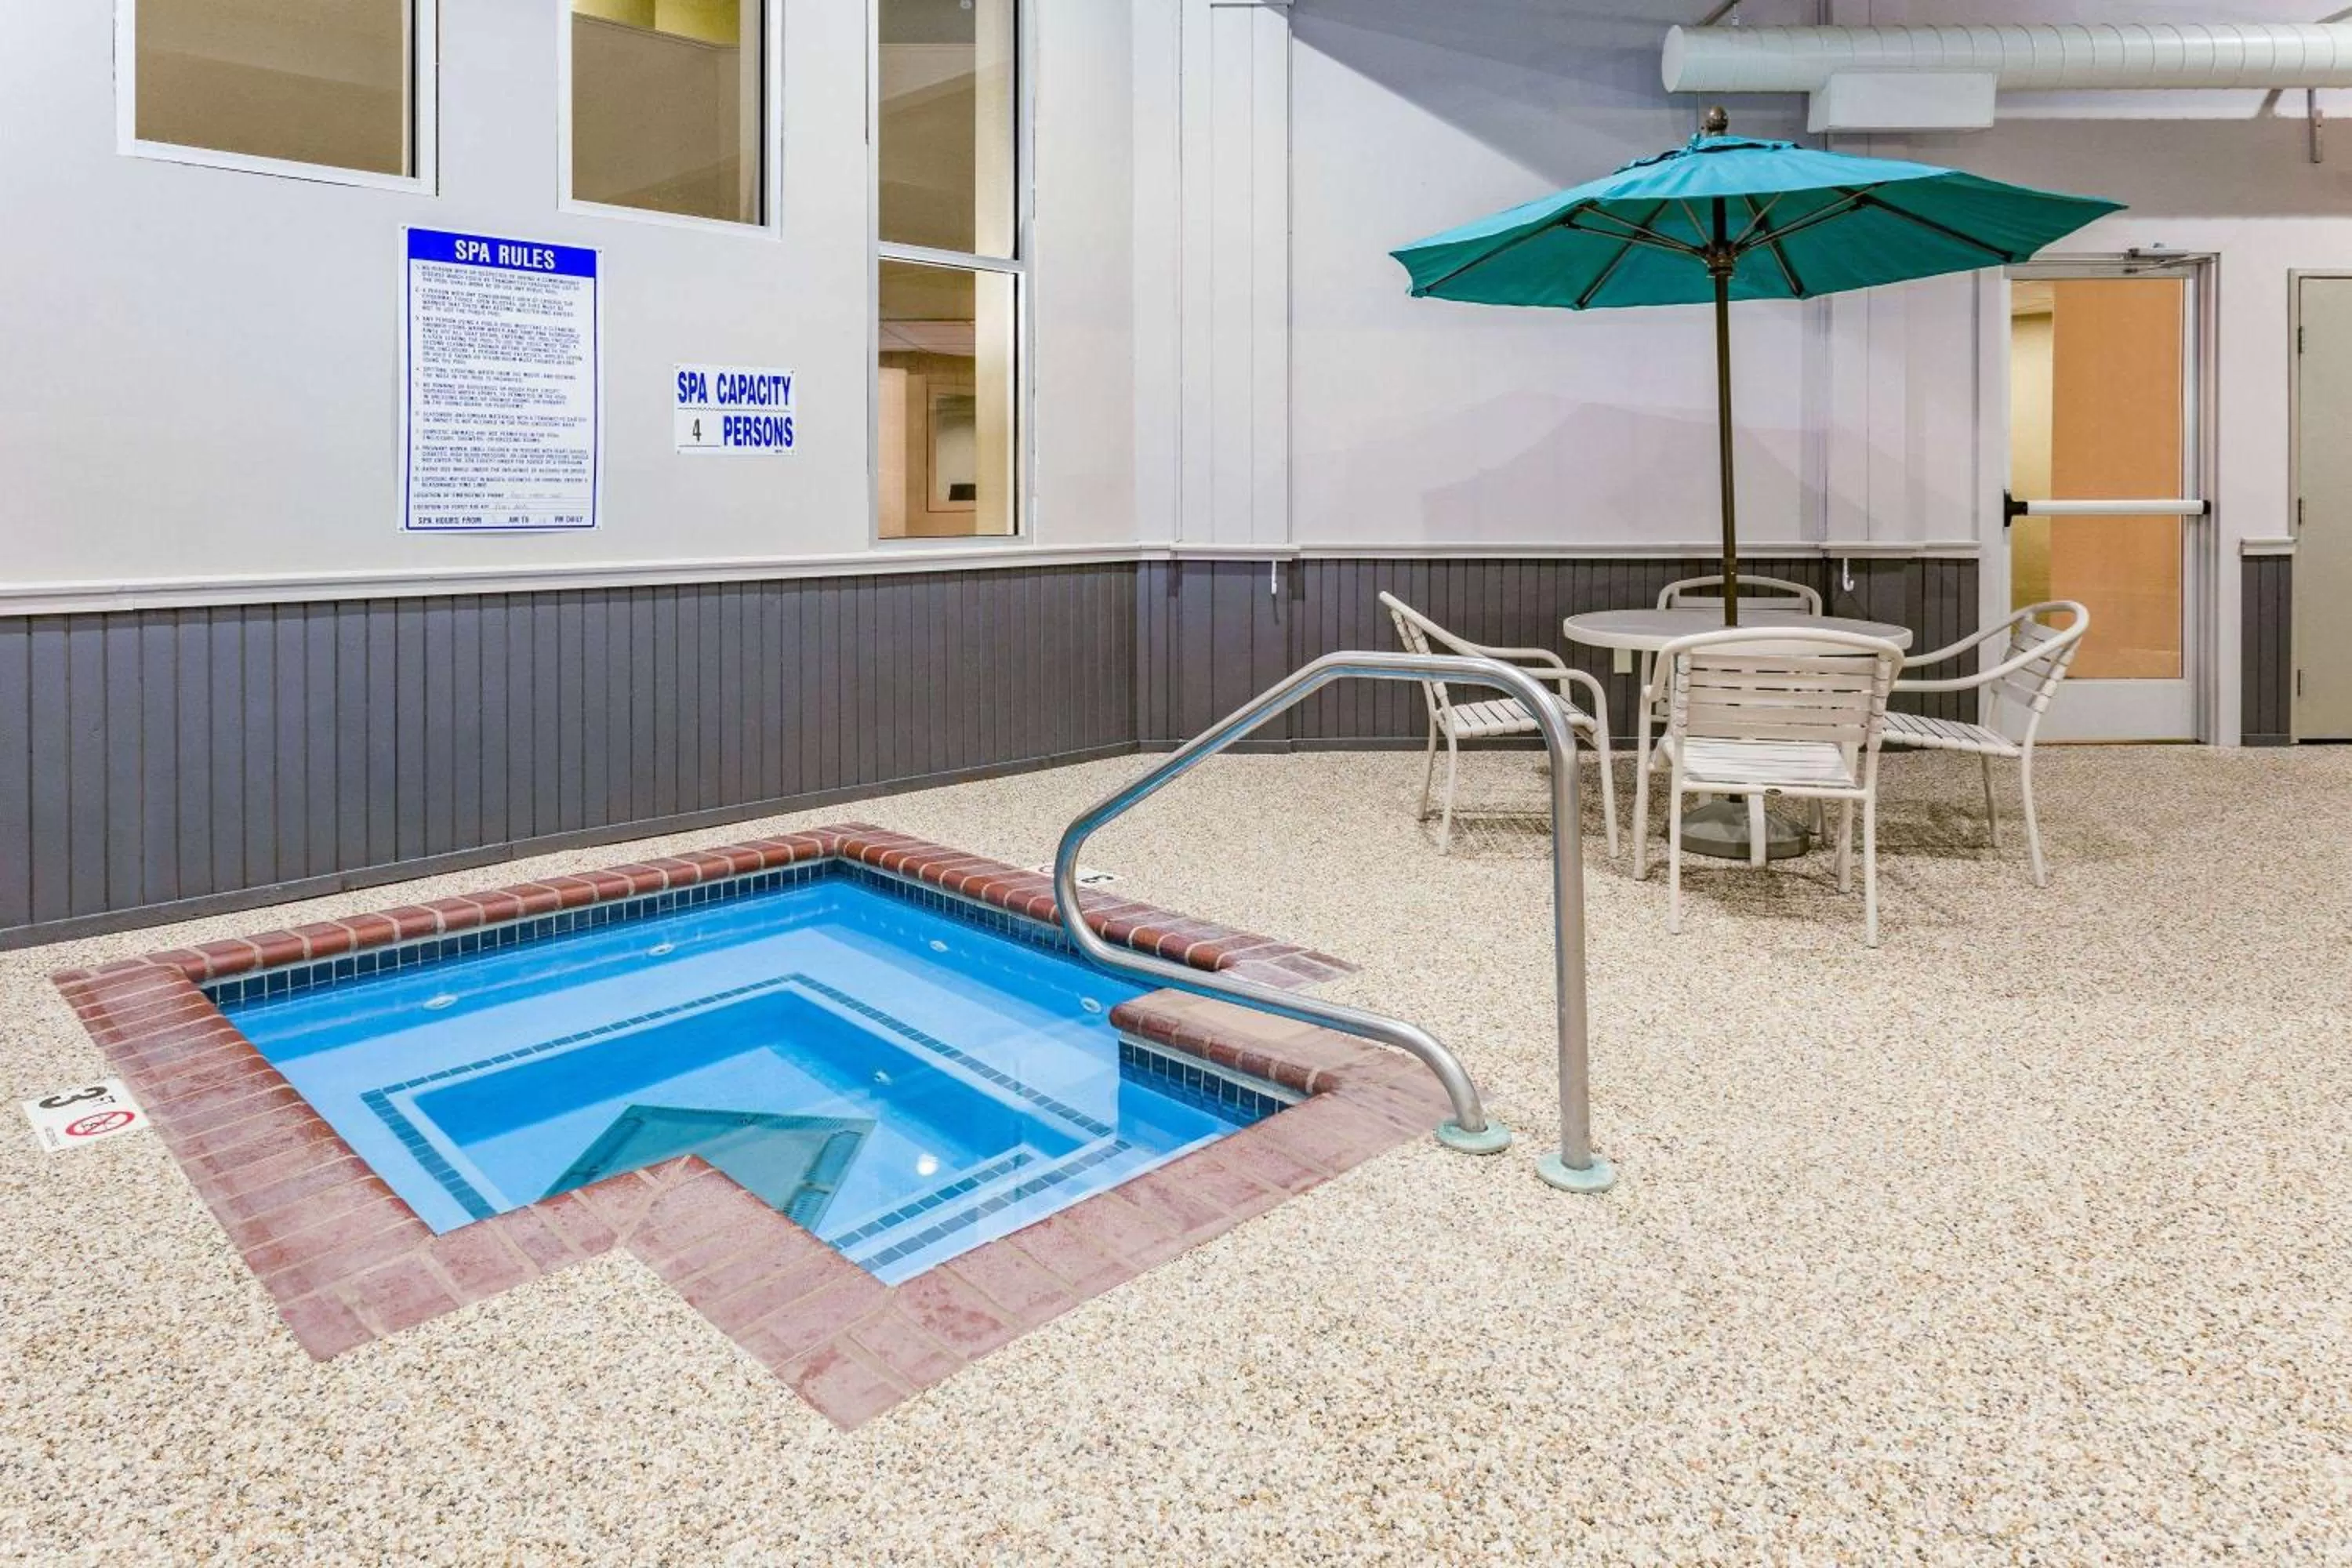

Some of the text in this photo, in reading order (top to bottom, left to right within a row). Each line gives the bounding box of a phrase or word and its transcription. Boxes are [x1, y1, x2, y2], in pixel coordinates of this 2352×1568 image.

[455, 239, 555, 270] SPA RULES
[677, 371, 791, 405] SPA CAPACITY
[692, 416, 793, 448] 4 PERSONS
[38, 1085, 107, 1109] 3
